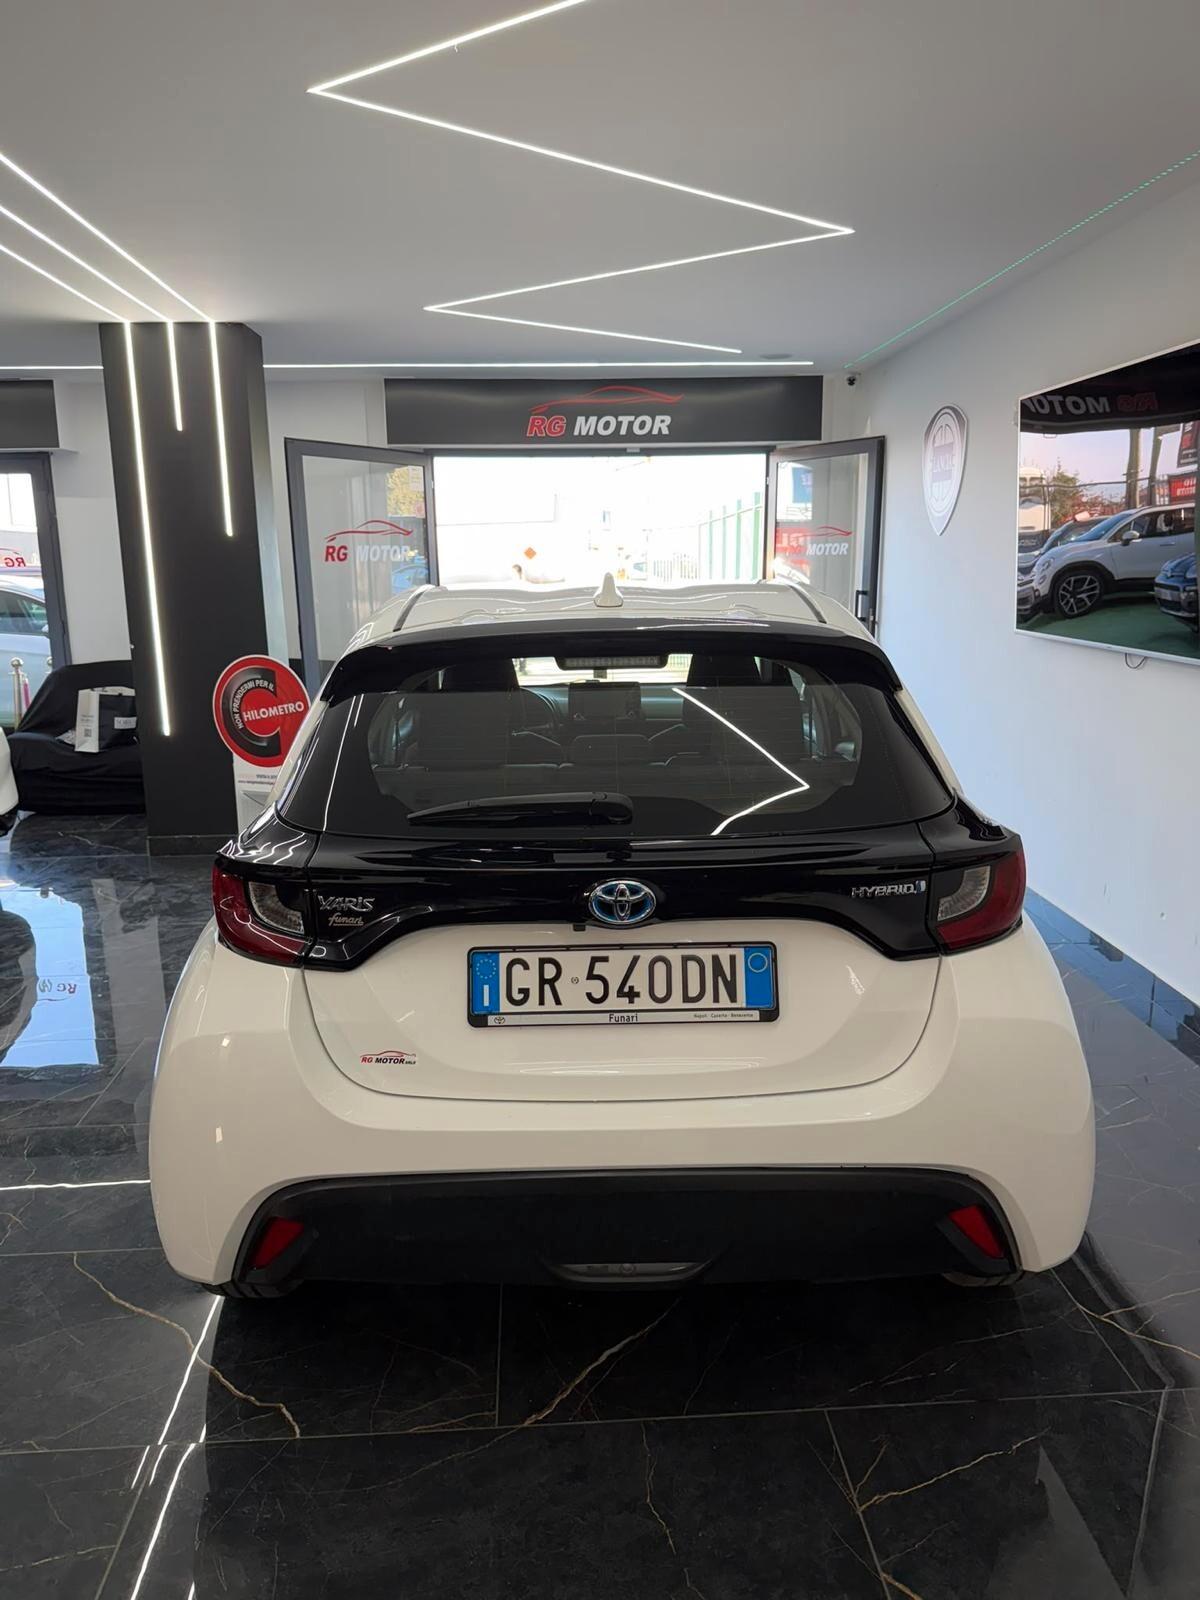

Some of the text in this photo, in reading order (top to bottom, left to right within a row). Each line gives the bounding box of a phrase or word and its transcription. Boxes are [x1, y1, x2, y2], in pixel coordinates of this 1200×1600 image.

[526, 415, 672, 437] RG MOTOR
[324, 544, 411, 562] RG MOTOR
[255, 680, 268, 688] PER
[233, 680, 255, 713] PRENDERMI
[234, 714, 245, 729] NON
[851, 883, 915, 898] HYBRID
[318, 896, 376, 911] YARIS
[505, 957, 563, 1006] GR
[585, 953, 739, 1005] 540DN
[608, 1013, 639, 1024] Funari
